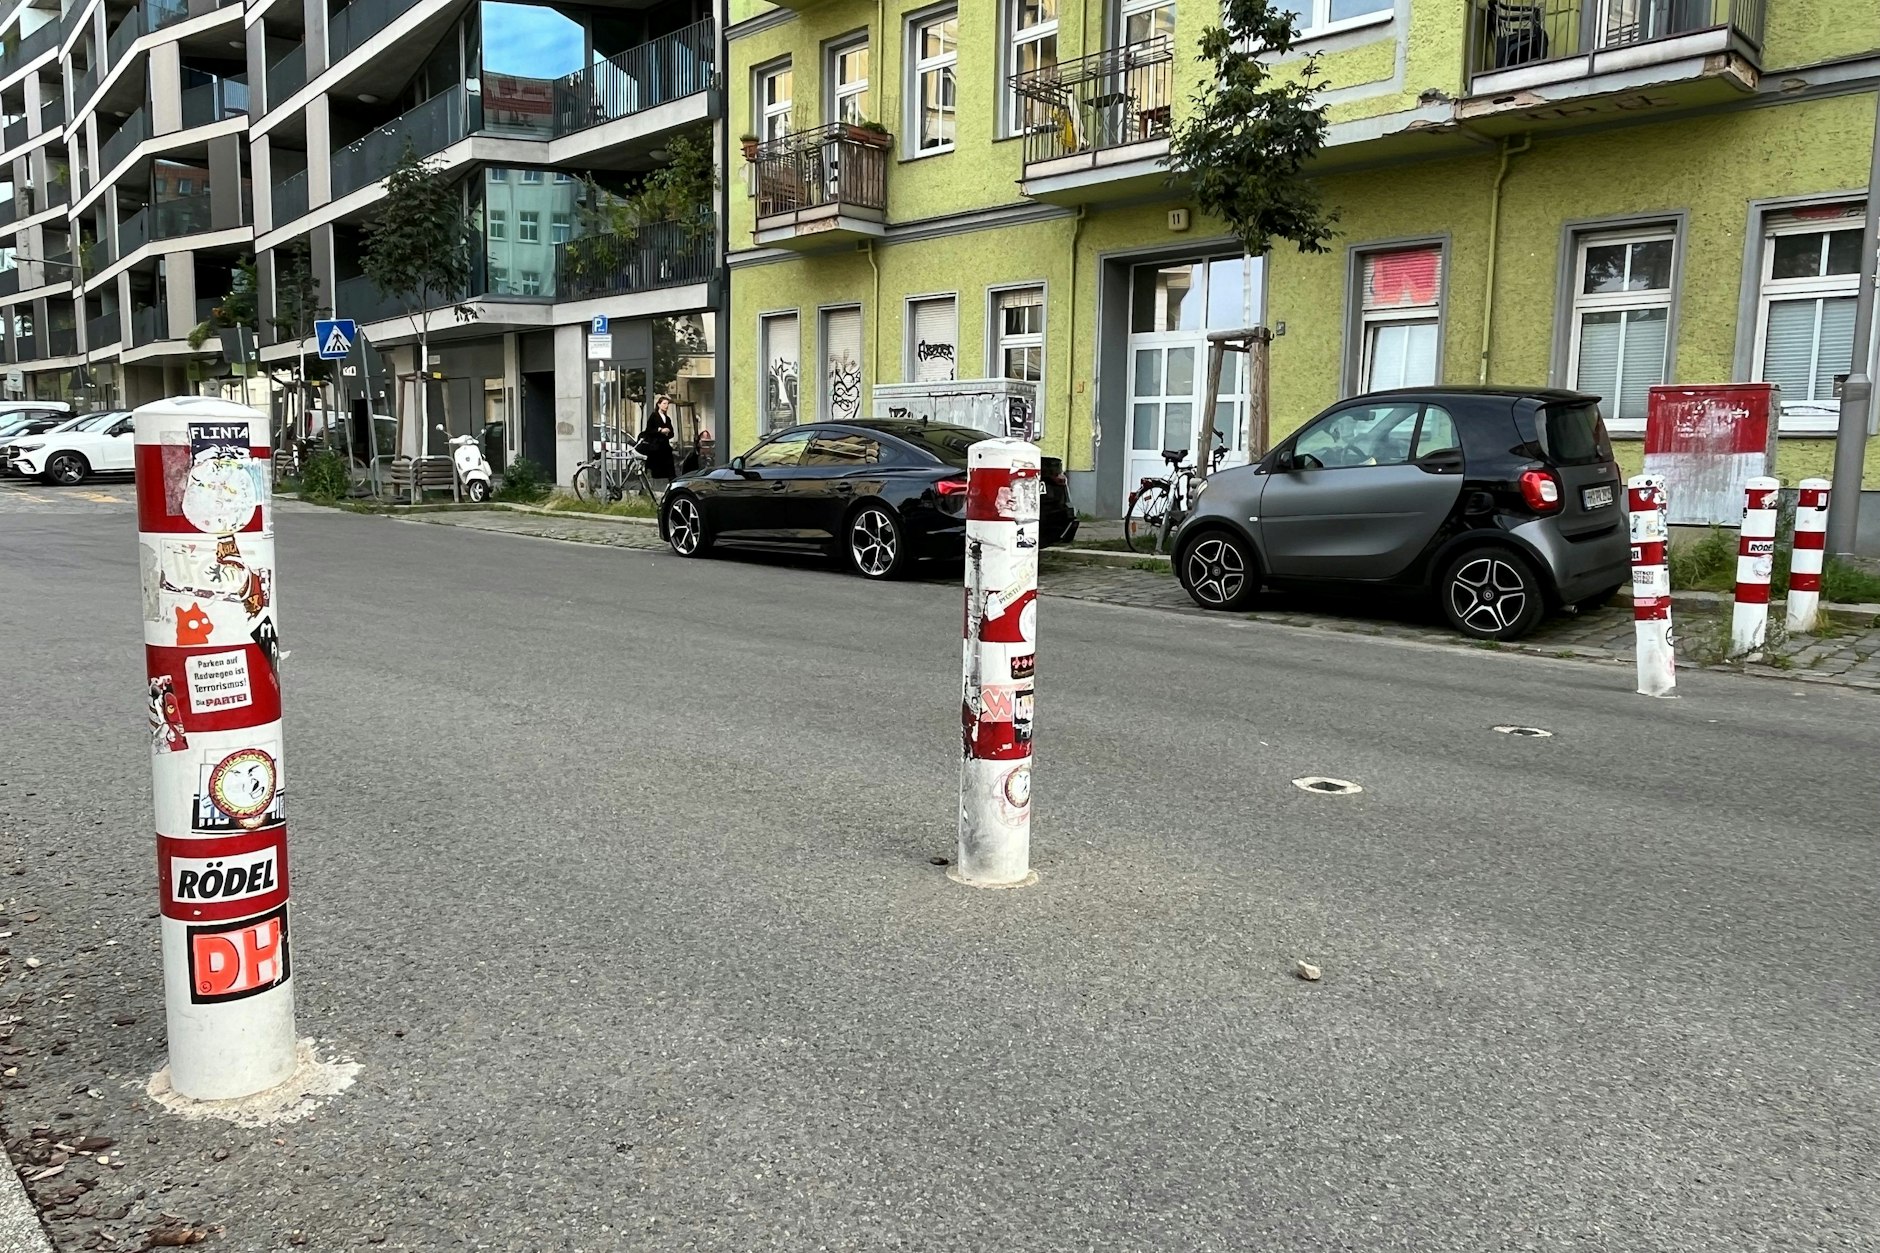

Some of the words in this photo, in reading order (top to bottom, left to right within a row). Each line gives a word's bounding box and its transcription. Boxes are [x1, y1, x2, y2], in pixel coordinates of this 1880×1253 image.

[1172, 213, 1180, 225] 11
[594, 318, 603, 332] P
[190, 426, 249, 440] FLINTA
[197, 659, 225, 669] Parken
[226, 656, 238, 666] auf
[194, 670, 234, 681] Radwegen
[235, 667, 245, 676] ist
[205, 693, 248, 707] PARTEI
[178, 859, 274, 898] RÖDEL
